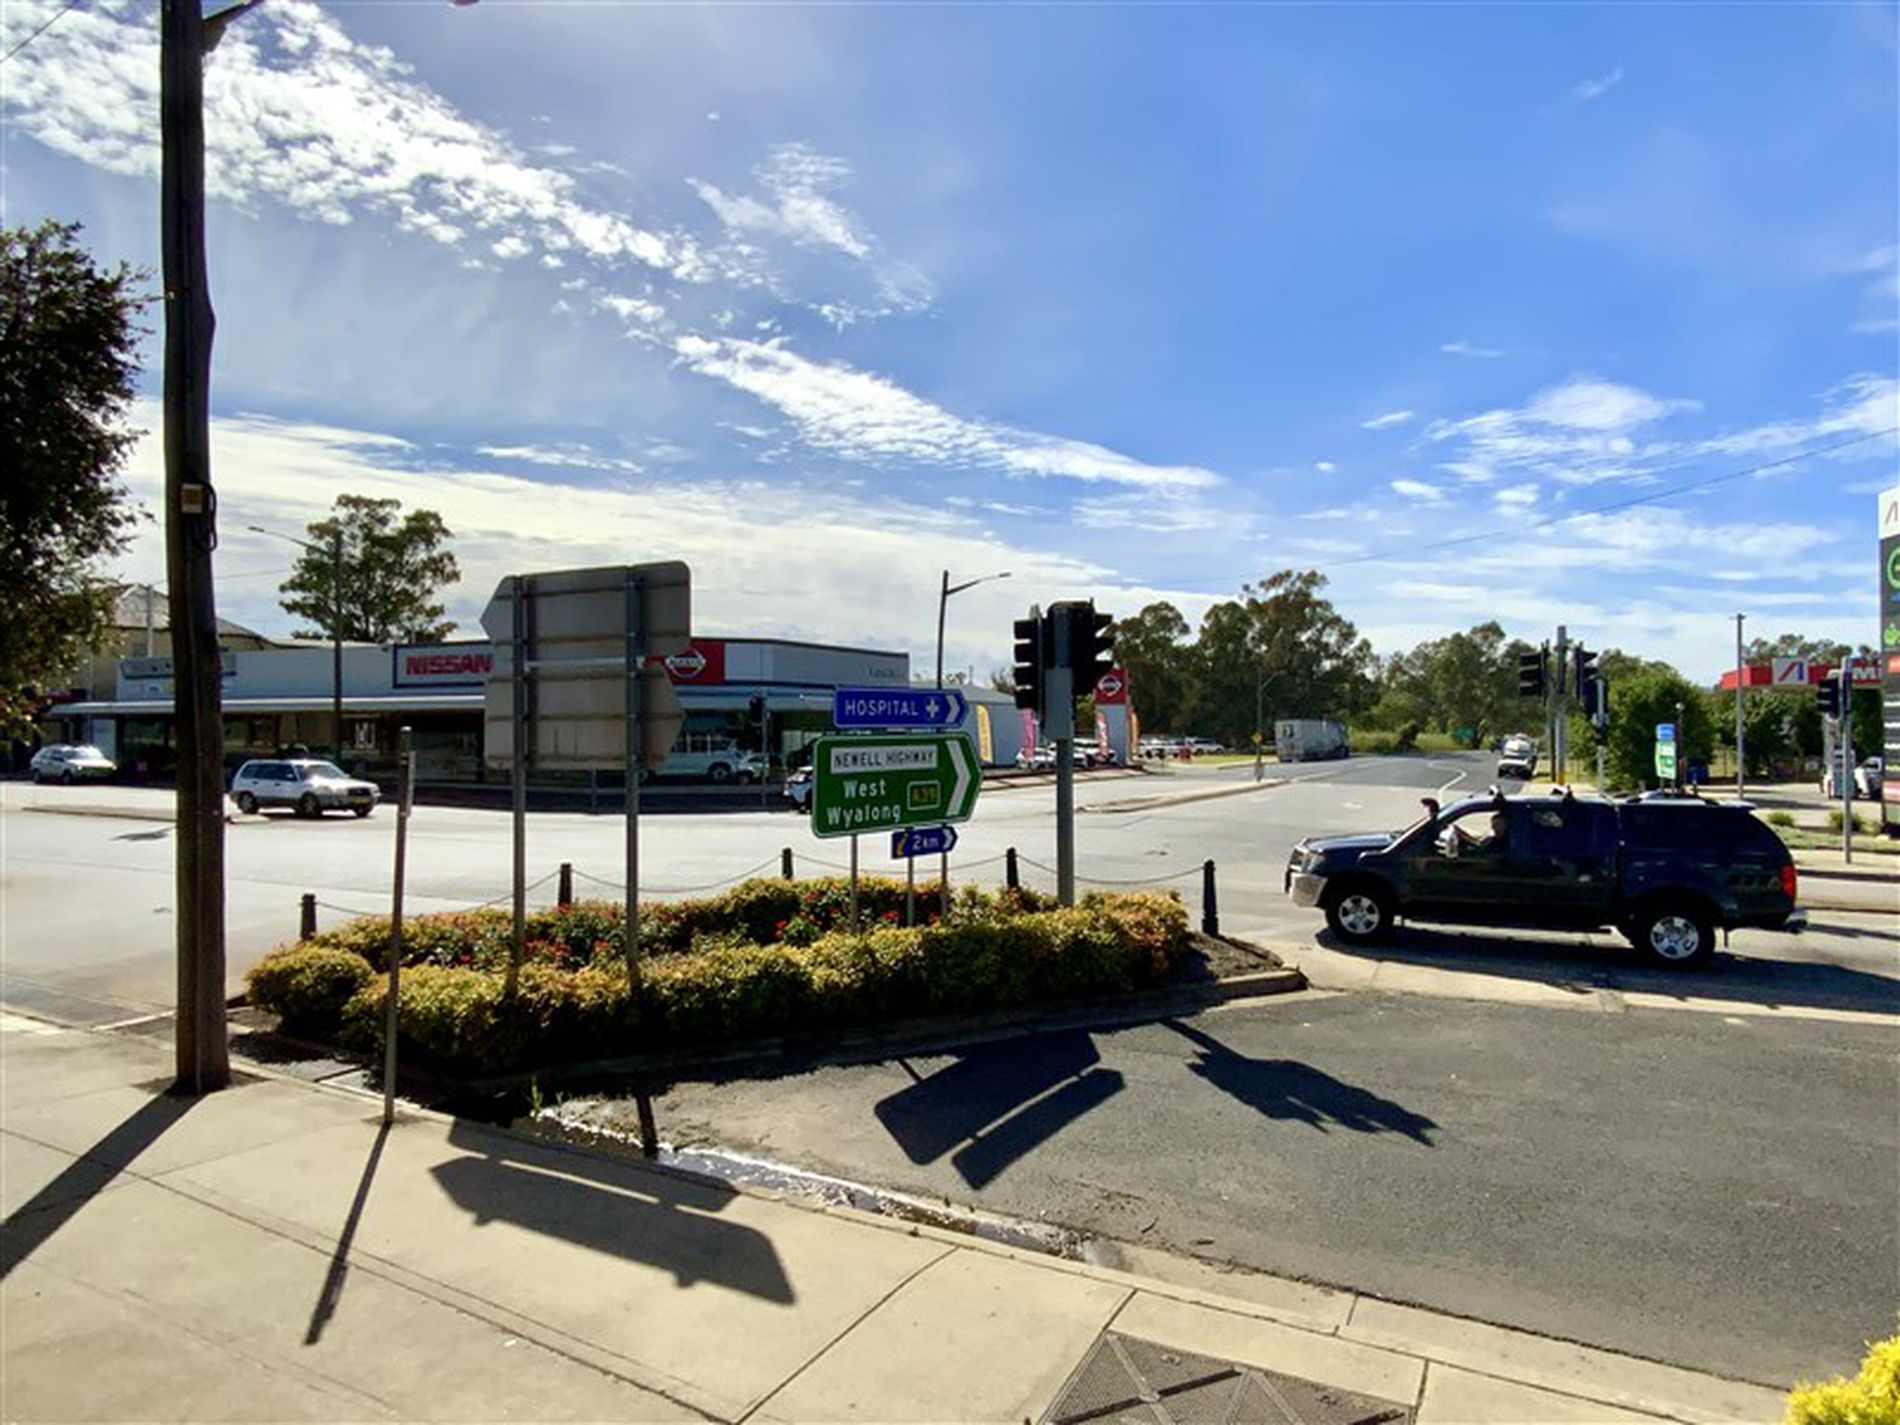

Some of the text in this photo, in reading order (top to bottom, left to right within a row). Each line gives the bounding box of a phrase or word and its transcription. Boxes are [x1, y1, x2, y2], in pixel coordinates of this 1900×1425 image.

[406, 654, 493, 675] NISSAN
[844, 700, 919, 716] HOSPITAL
[834, 750, 933, 768] NEWELL HIGHWAY
[843, 778, 887, 799] West
[827, 804, 901, 829] Wyalong
